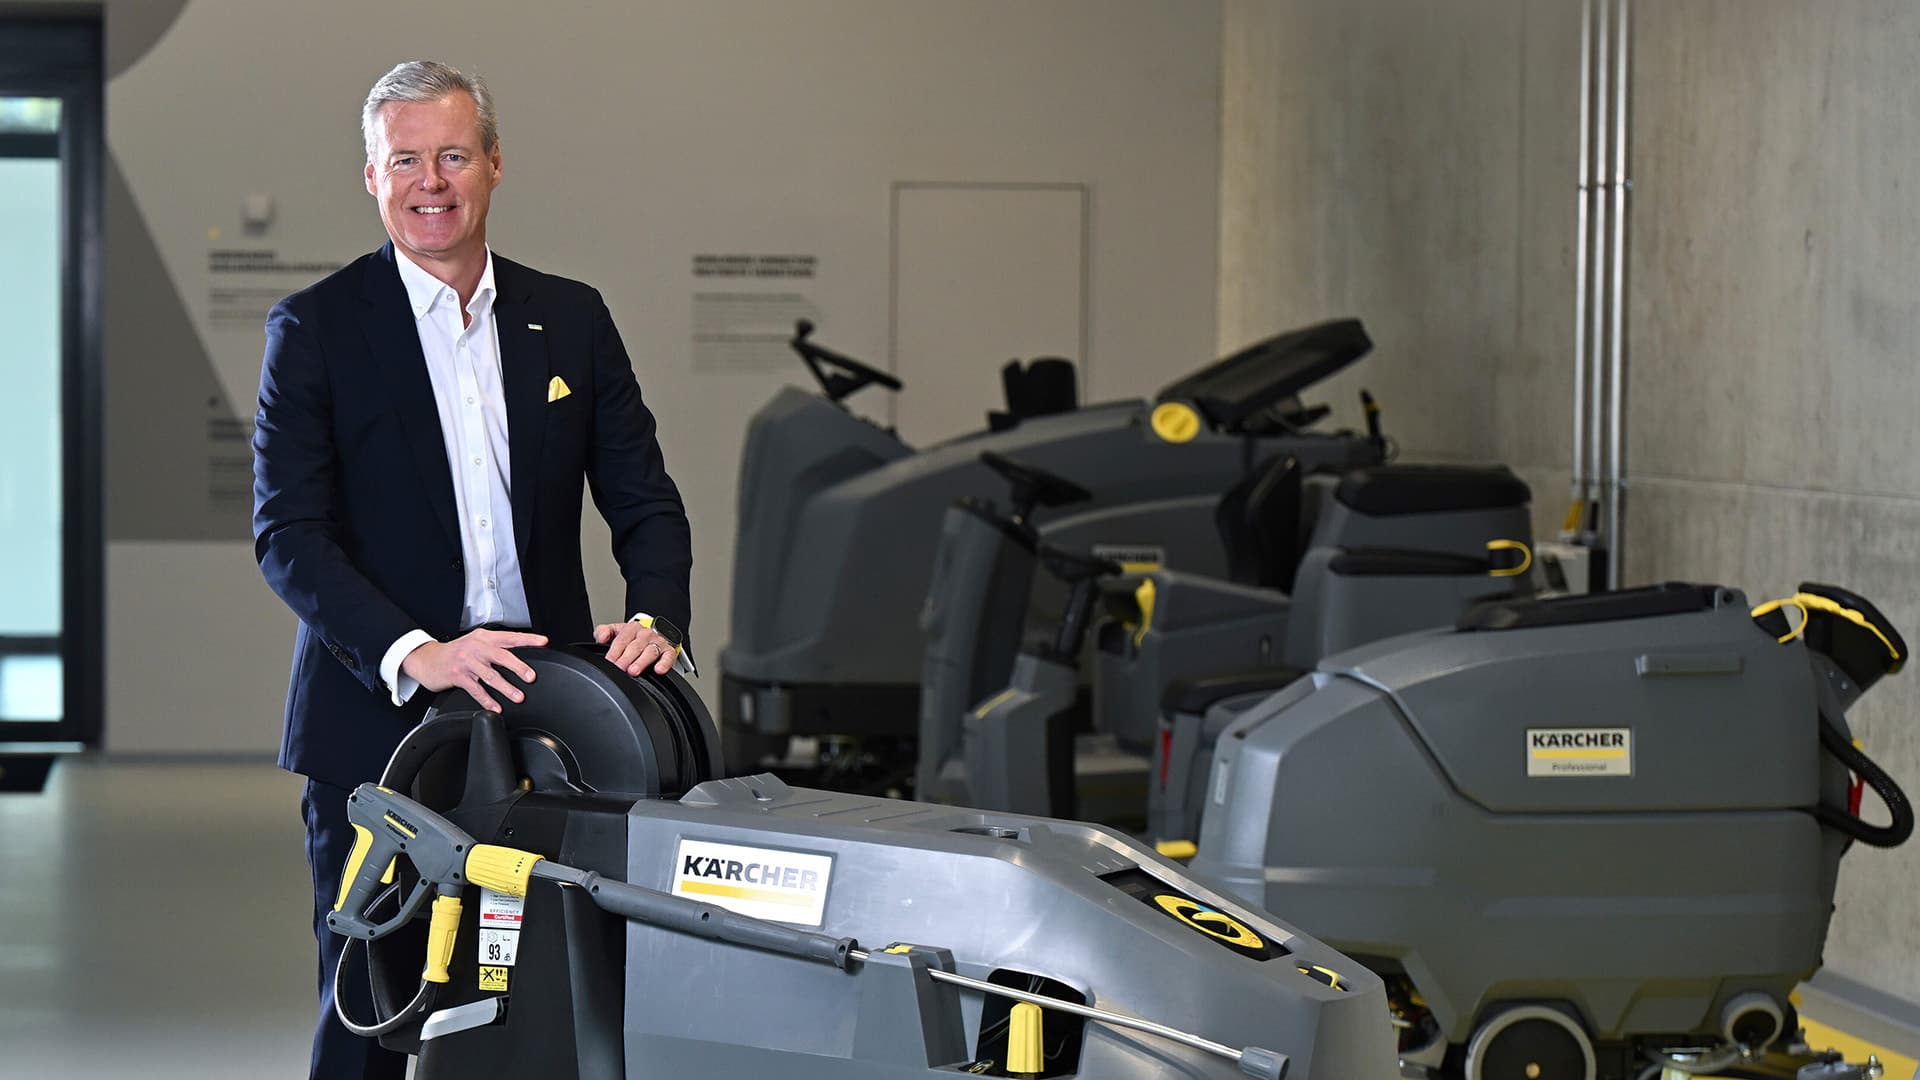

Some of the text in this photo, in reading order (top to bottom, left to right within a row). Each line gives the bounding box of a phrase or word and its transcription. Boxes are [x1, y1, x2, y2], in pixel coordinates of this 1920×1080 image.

[1532, 733, 1624, 748] KÄRCHER
[1551, 762, 1607, 772] Professional
[683, 854, 819, 892] KÄRCHER
[488, 943, 501, 961] 93
